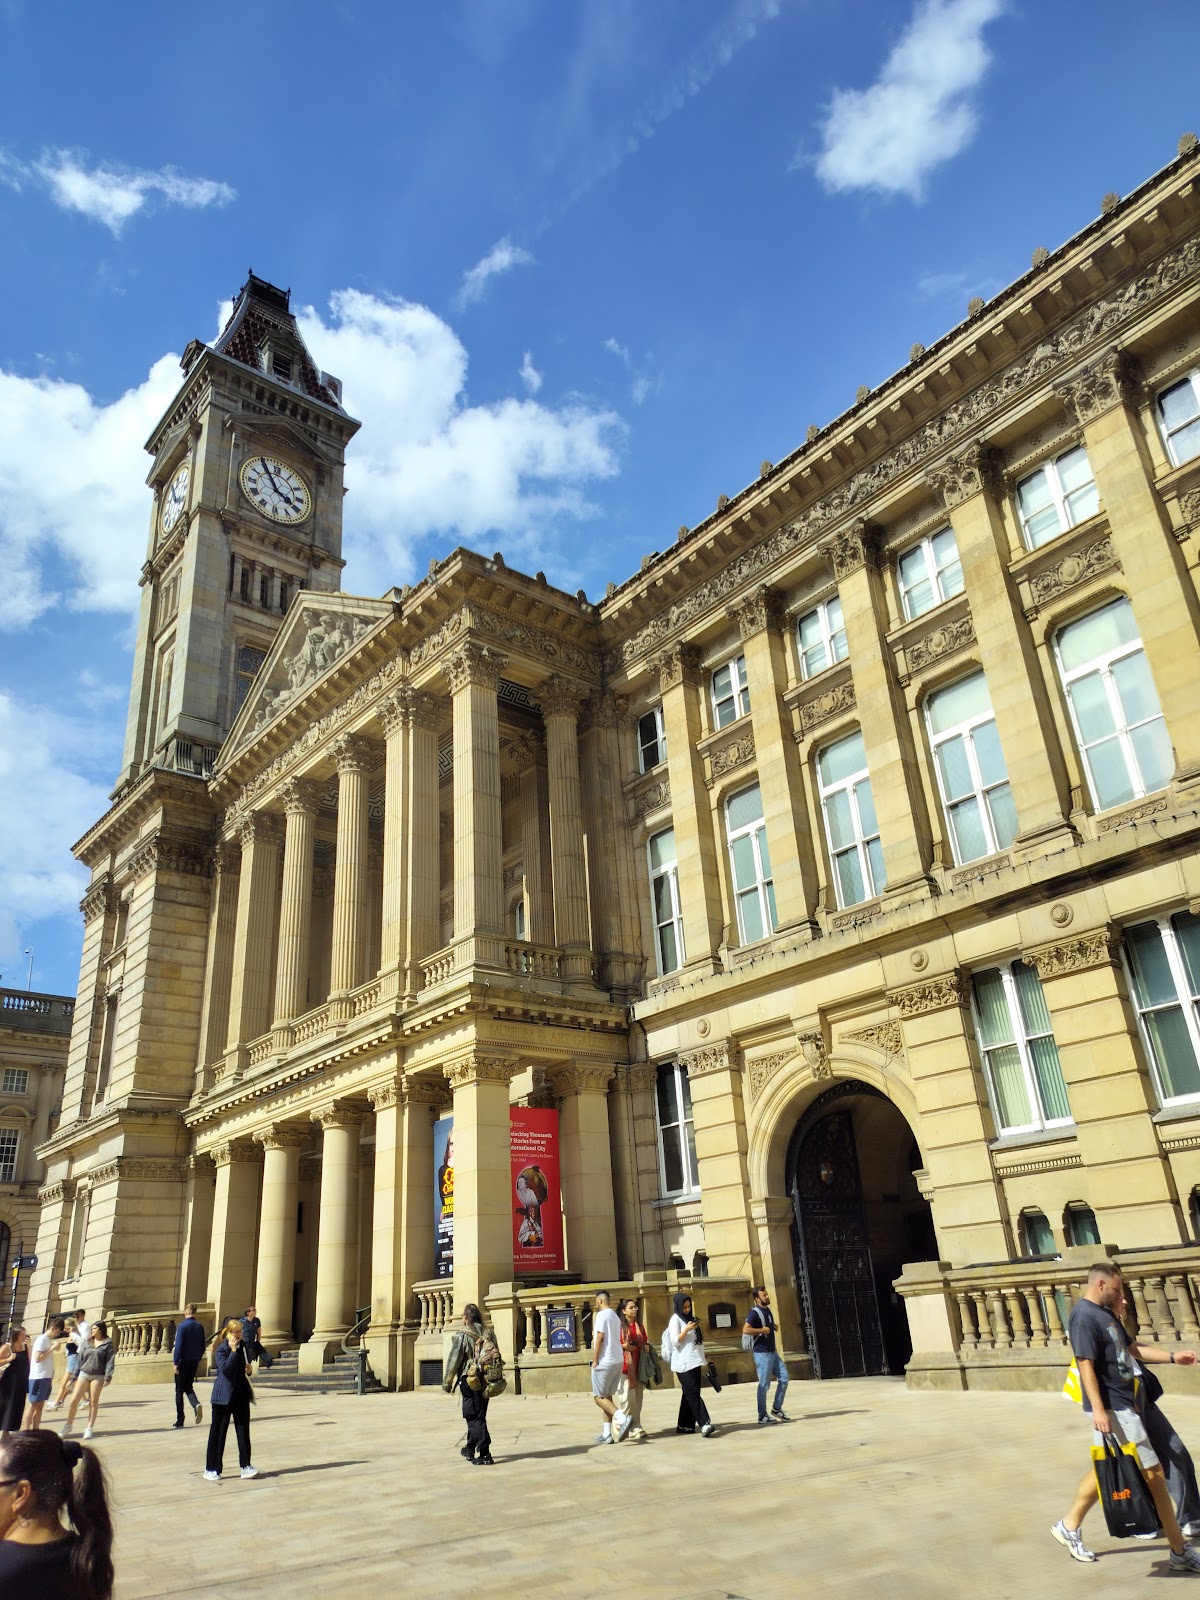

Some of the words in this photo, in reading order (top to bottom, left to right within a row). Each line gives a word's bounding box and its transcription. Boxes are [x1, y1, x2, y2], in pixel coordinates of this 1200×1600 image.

[489, 1023, 534, 1039] MUSEUM
[550, 1031, 571, 1043] ART
[573, 1034, 616, 1048] GALLERY
